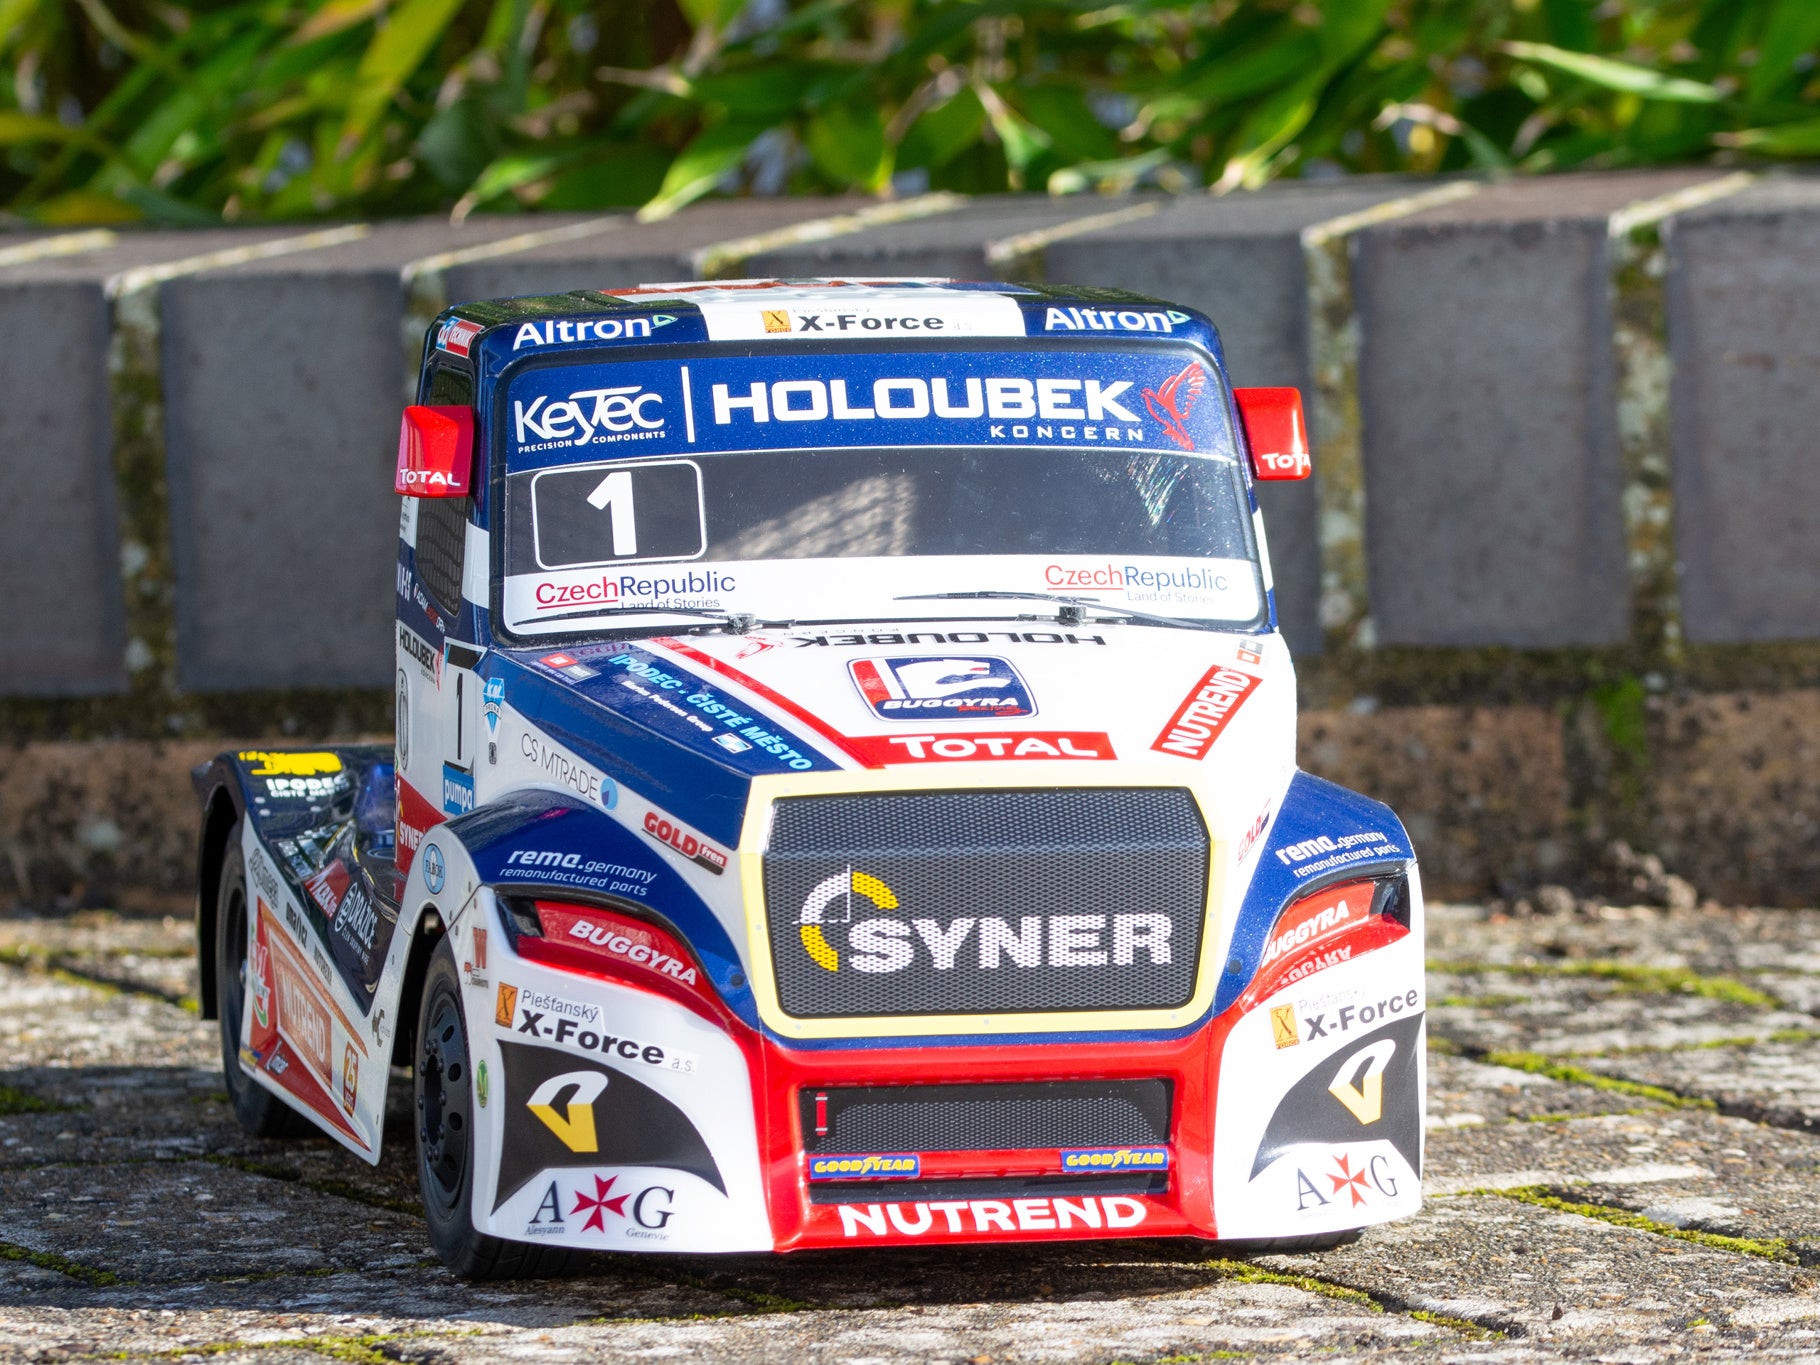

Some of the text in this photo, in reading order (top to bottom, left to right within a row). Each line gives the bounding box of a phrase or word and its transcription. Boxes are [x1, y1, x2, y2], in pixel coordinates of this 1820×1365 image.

[513, 318, 651, 350] Altron
[798, 315, 944, 332] X-Force
[1045, 307, 1172, 333] Altron
[712, 378, 1141, 425] HOLOUBEK
[518, 431, 666, 453] PRECISION COMPONENTS
[991, 425, 1144, 442] KONCERN
[400, 469, 461, 487] TOTAL
[586, 471, 637, 557] 1
[673, 597, 720, 609] Stories
[791, 633, 1107, 648] HOLOUBEK
[608, 653, 682, 690] IPODEC
[739, 725, 813, 770] MĚSTO
[883, 698, 1018, 710] BUGGYRA
[1161, 670, 1251, 756] NUTREND
[889, 736, 1098, 760] TOTAL
[541, 745, 598, 801] MTRADE
[445, 780, 473, 813] pumpa
[644, 812, 699, 857] GOLD
[1293, 844, 1401, 879] remanufactured parts
[499, 868, 648, 896] remanufactured parts
[569, 919, 698, 987] BUGGYRA
[848, 912, 1173, 974] SYNER
[1304, 989, 1418, 1042] X-Force
[518, 1008, 664, 1065] X-Force
[814, 1156, 916, 1175] GOODYEAR
[1066, 1150, 1165, 1169] GOODYEAR
[1296, 1155, 1398, 1211] A G
[528, 1180, 675, 1229] A G
[839, 1196, 1147, 1238] NUTREND
